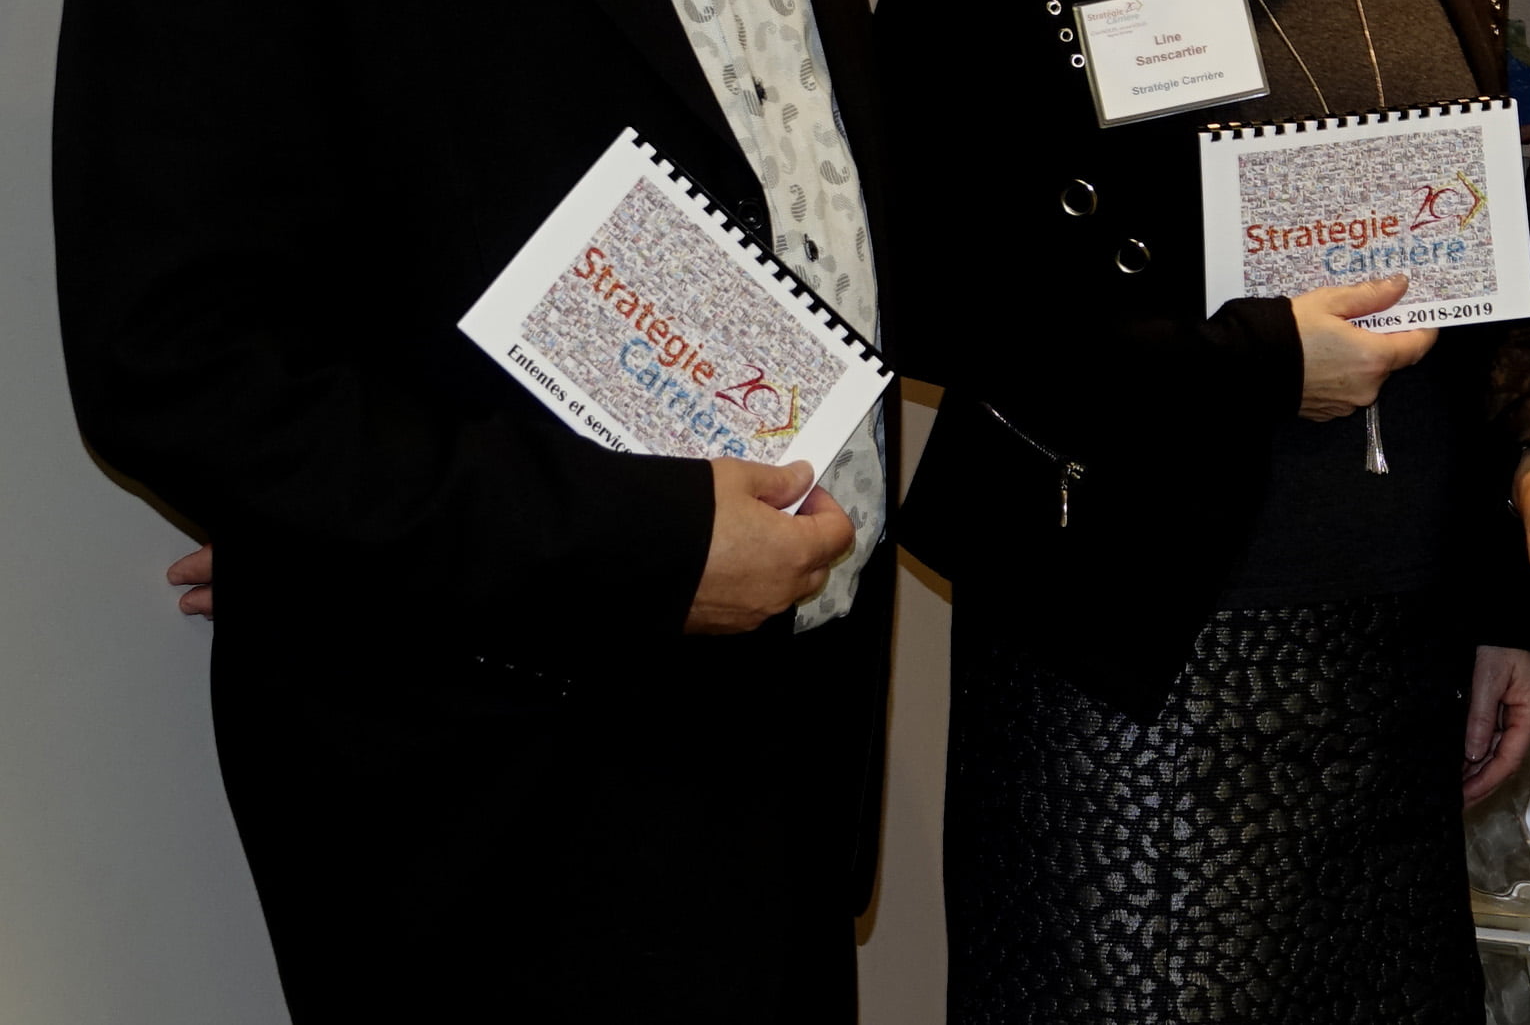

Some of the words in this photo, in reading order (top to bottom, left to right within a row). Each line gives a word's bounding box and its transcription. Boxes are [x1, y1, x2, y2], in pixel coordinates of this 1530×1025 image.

[1135, 44, 1208, 67] Sanscartier
[1154, 32, 1182, 46] Line
[1132, 78, 1180, 96] Stratégie
[1182, 70, 1225, 86] Carrière
[1247, 210, 1400, 254] Stratégie
[1324, 235, 1467, 275] Carrière
[572, 246, 715, 386] Stratégie
[1351, 315, 1402, 328] ervices
[1408, 302, 1493, 324] 2018-2019
[507, 344, 568, 402] Ententes
[568, 400, 585, 417] et
[619, 336, 748, 458] Carrière
